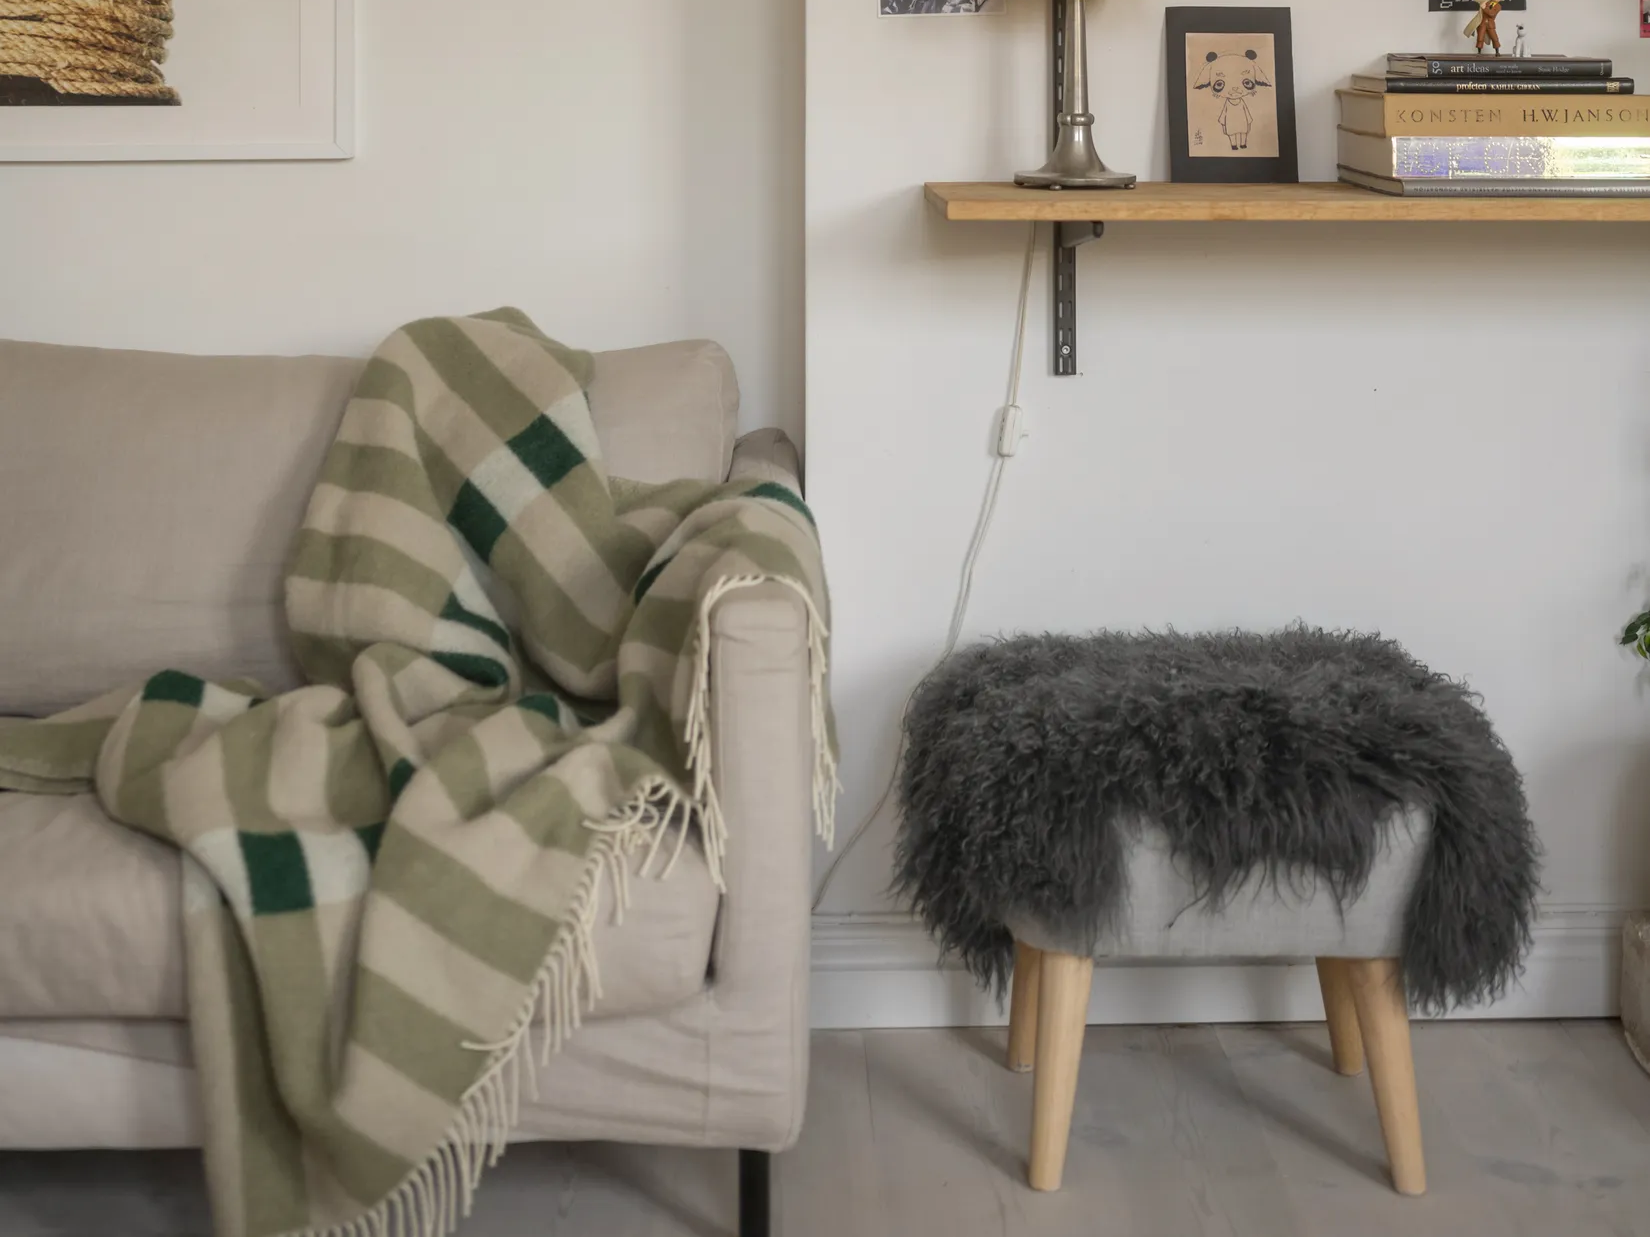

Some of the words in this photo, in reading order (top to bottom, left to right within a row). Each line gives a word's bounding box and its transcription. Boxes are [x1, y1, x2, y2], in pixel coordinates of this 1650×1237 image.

[1450, 64, 1464, 73] art
[1466, 63, 1490, 73] ideas
[1456, 81, 1487, 93] profeten
[1395, 109, 1502, 123] KONSTEN
